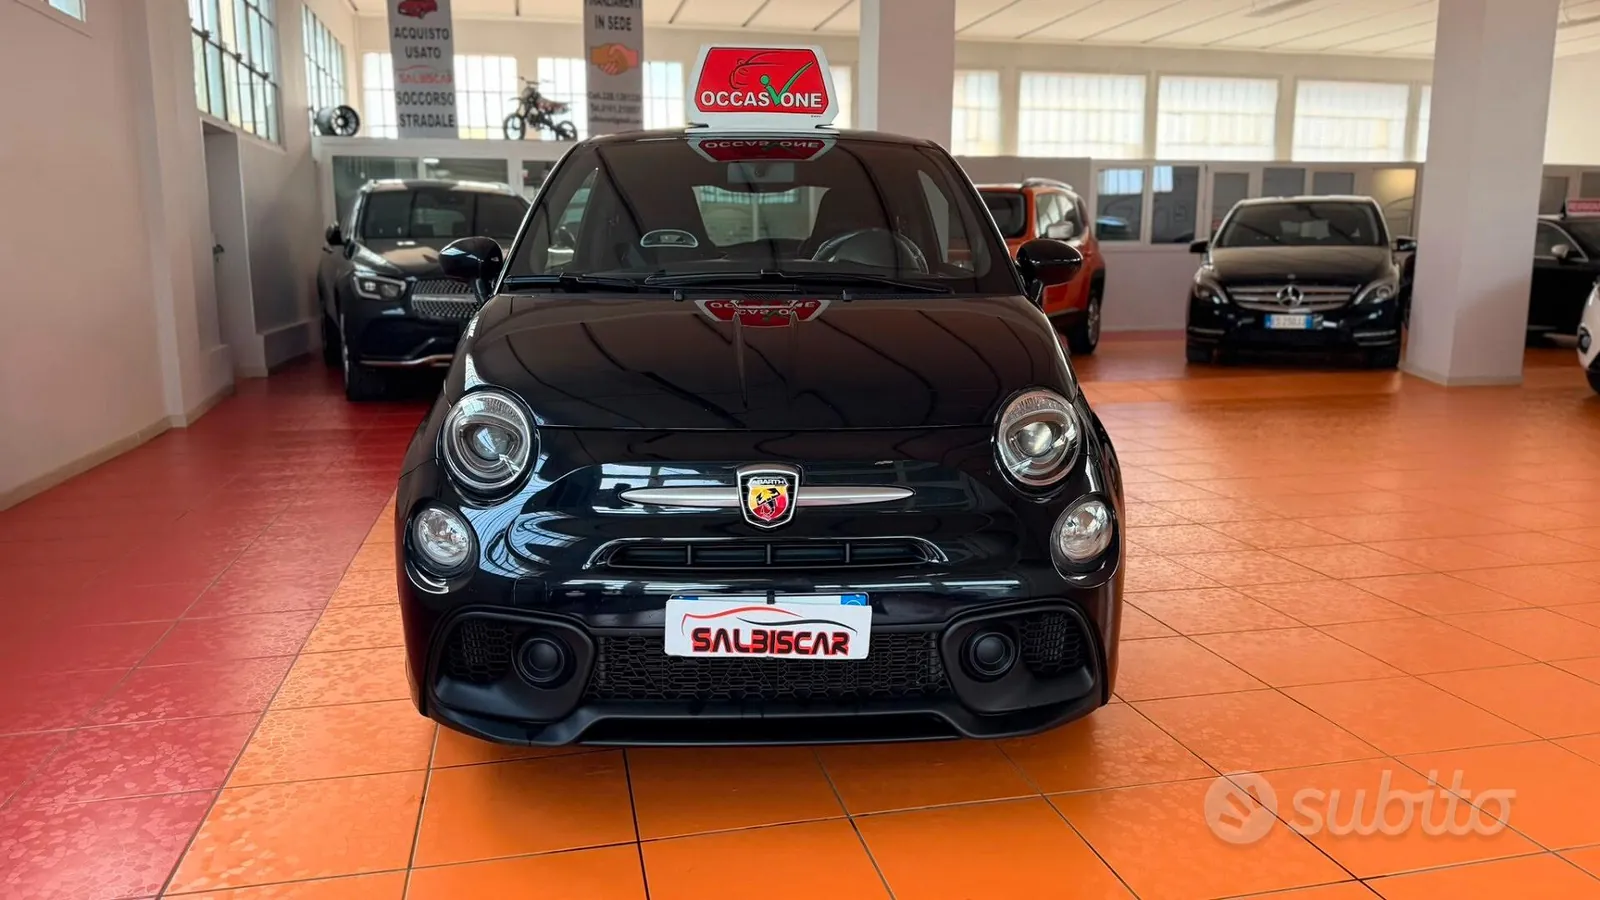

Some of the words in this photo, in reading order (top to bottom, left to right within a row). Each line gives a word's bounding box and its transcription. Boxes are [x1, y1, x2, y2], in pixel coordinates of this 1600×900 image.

[594, 14, 605, 30] IN
[607, 15, 632, 31] SEDE
[394, 27, 450, 40] ACQUISTO
[404, 46, 441, 59] USATO
[396, 91, 455, 106] SOCCORSO
[400, 113, 455, 128] STRADALE
[691, 627, 850, 656] SALBISCAR
